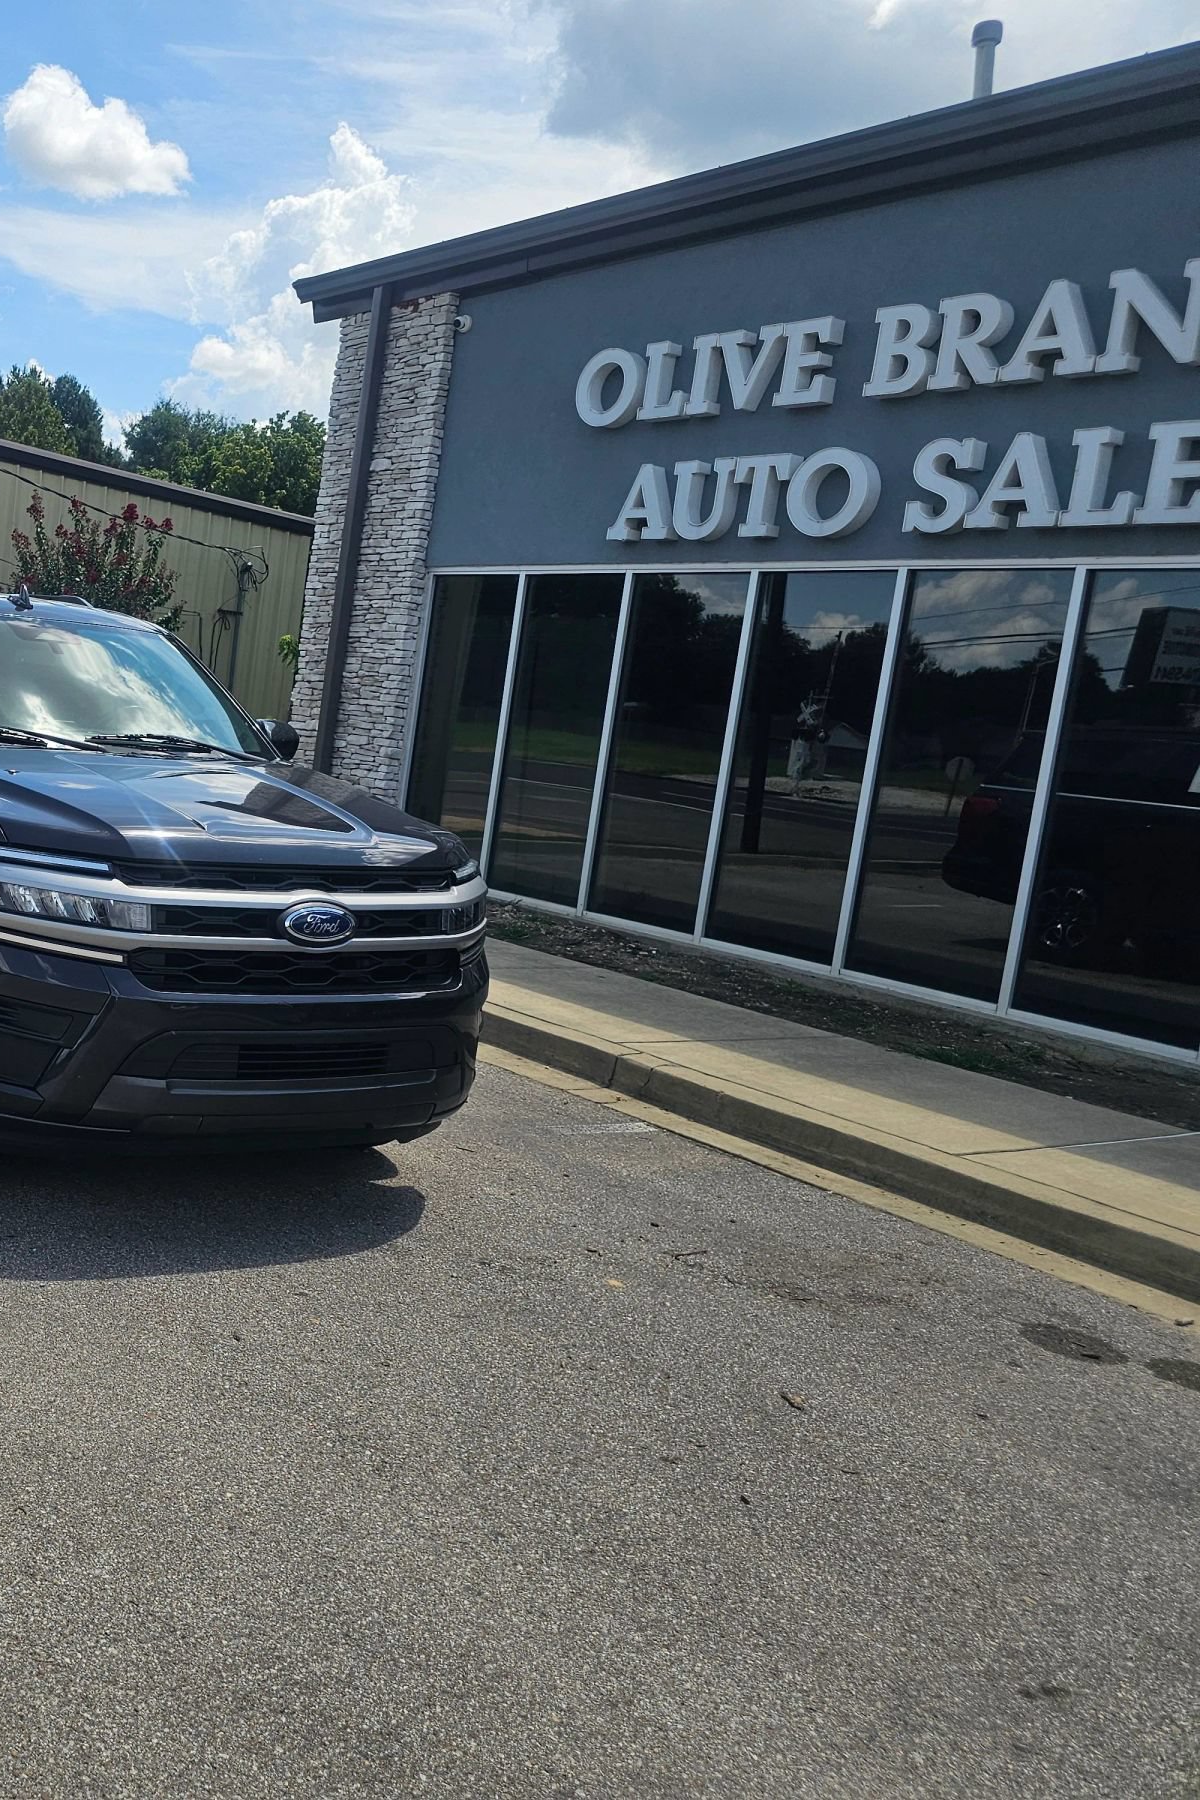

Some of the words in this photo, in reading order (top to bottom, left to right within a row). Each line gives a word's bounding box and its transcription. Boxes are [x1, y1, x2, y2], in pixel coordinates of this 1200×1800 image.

[575, 315, 846, 428] OLIVE
[862, 257, 1200, 399] BRAN
[606, 446, 881, 541] AUTO
[902, 421, 1200, 534] SALE
[303, 913, 341, 933] Ford
